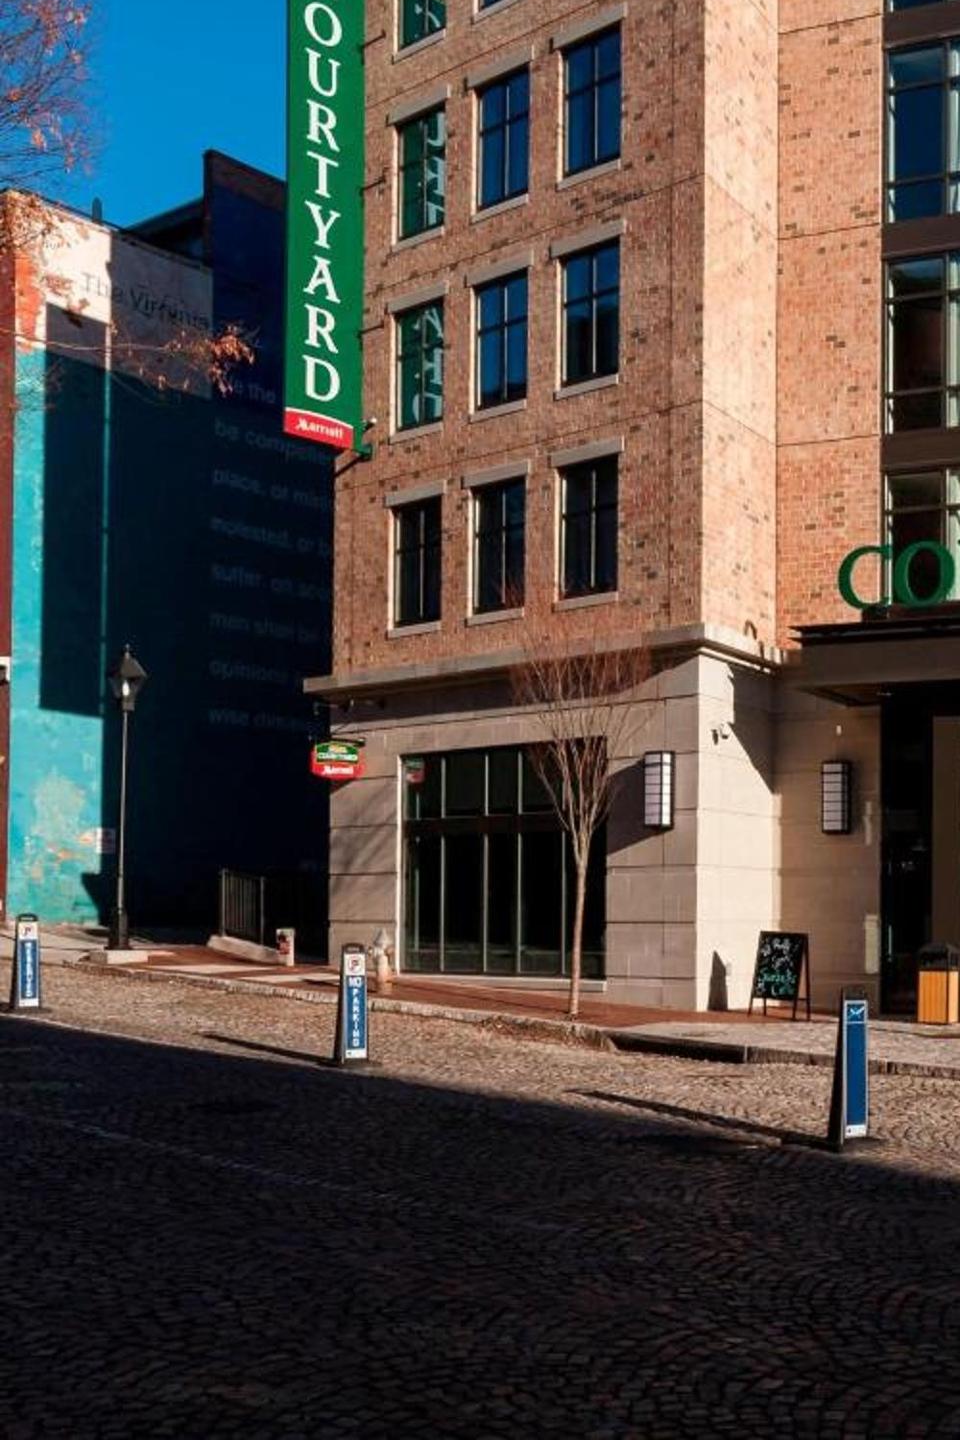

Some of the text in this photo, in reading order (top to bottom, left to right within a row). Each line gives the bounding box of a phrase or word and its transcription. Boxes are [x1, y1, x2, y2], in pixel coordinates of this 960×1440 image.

[296, 418, 343, 439] Marriott
[349, 976, 362, 988] NO
[352, 988, 360, 1047] PARKING
